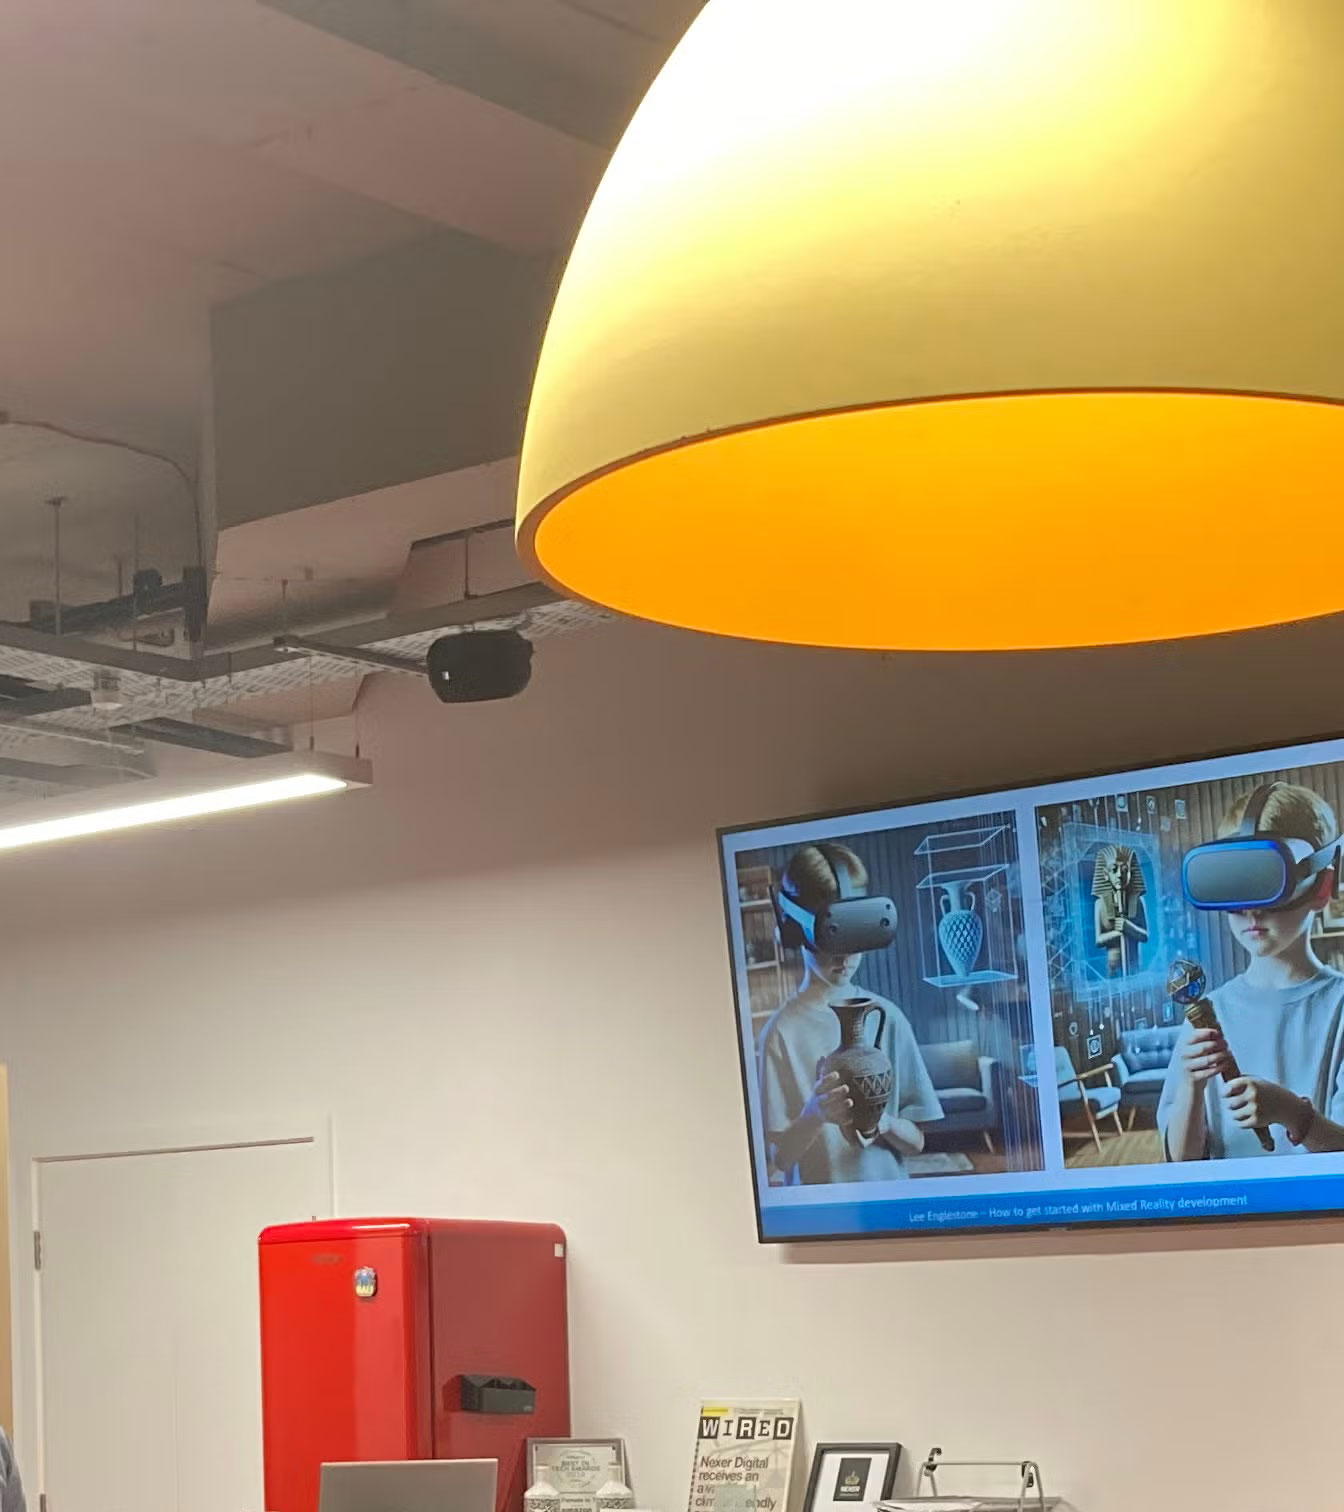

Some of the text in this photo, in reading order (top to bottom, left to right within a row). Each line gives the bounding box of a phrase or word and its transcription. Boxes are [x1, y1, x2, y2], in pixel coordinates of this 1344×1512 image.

[909, 1212, 925, 1223] Lee
[989, 1208, 1011, 1218] How
[1013, 1208, 1024, 1217] to
[1026, 1207, 1041, 1219] get
[1045, 1204, 1079, 1215] started
[1082, 1203, 1104, 1214] with
[1106, 1201, 1138, 1212] Mixed
[1141, 1199, 1175, 1211] Reality
[1178, 1195, 1248, 1209] development
[697, 1416, 794, 1440] WIRED
[700, 1456, 769, 1471] Nexer Digital
[699, 1471, 759, 1482] receives an
